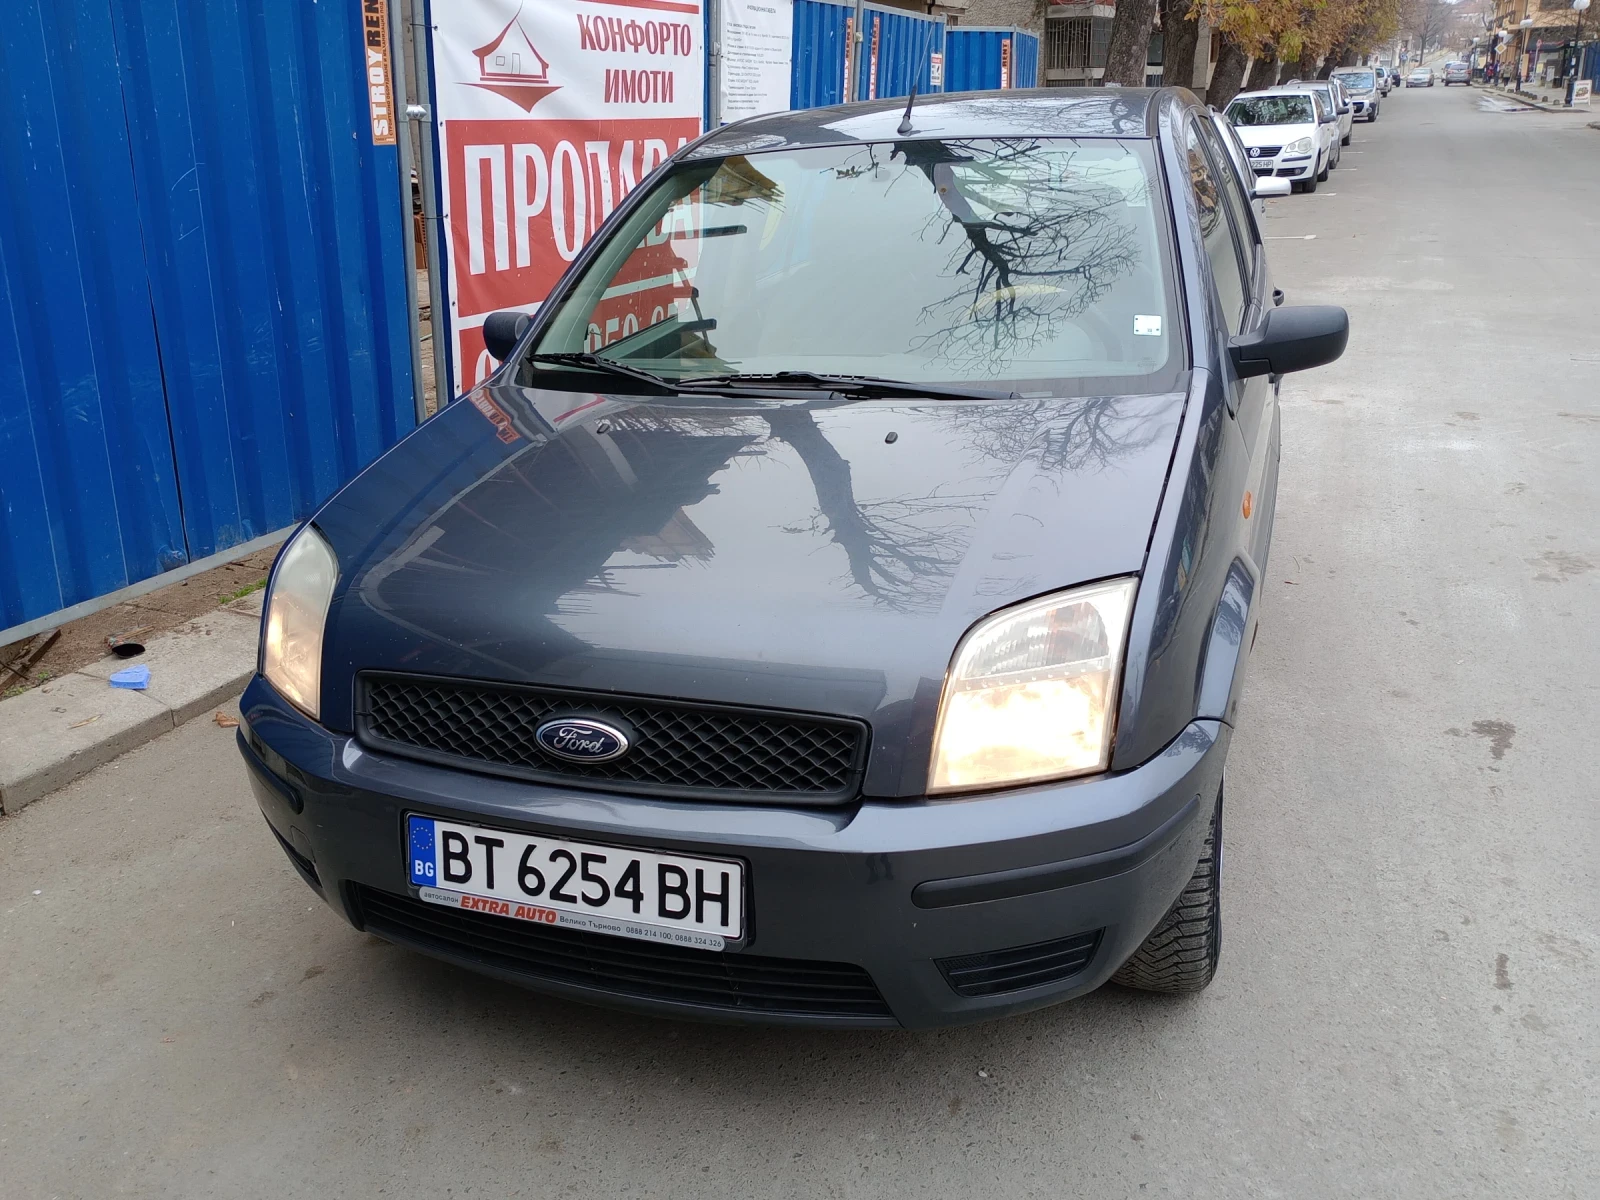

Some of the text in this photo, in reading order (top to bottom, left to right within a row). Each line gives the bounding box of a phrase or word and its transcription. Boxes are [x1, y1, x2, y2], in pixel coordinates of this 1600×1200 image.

[577, 14, 692, 56] КОНФОРТО
[363, 0, 388, 136] STROYREN
[604, 69, 673, 104] ИМОТИ
[553, 727, 605, 753] Ford
[414, 860, 434, 877] BG
[442, 831, 729, 927] BT 6254 BH
[424, 892, 459, 904] автосалон
[460, 895, 510, 916] EXTRA
[514, 905, 557, 924] AUTO
[559, 915, 587, 926] Велико
[588, 920, 621, 932] Търново
[626, 926, 643, 935] 0888
[644, 929, 657, 938] 214
[675, 934, 692, 943] 0888
[694, 937, 707, 945] 324
[708, 939, 722, 948] 326
